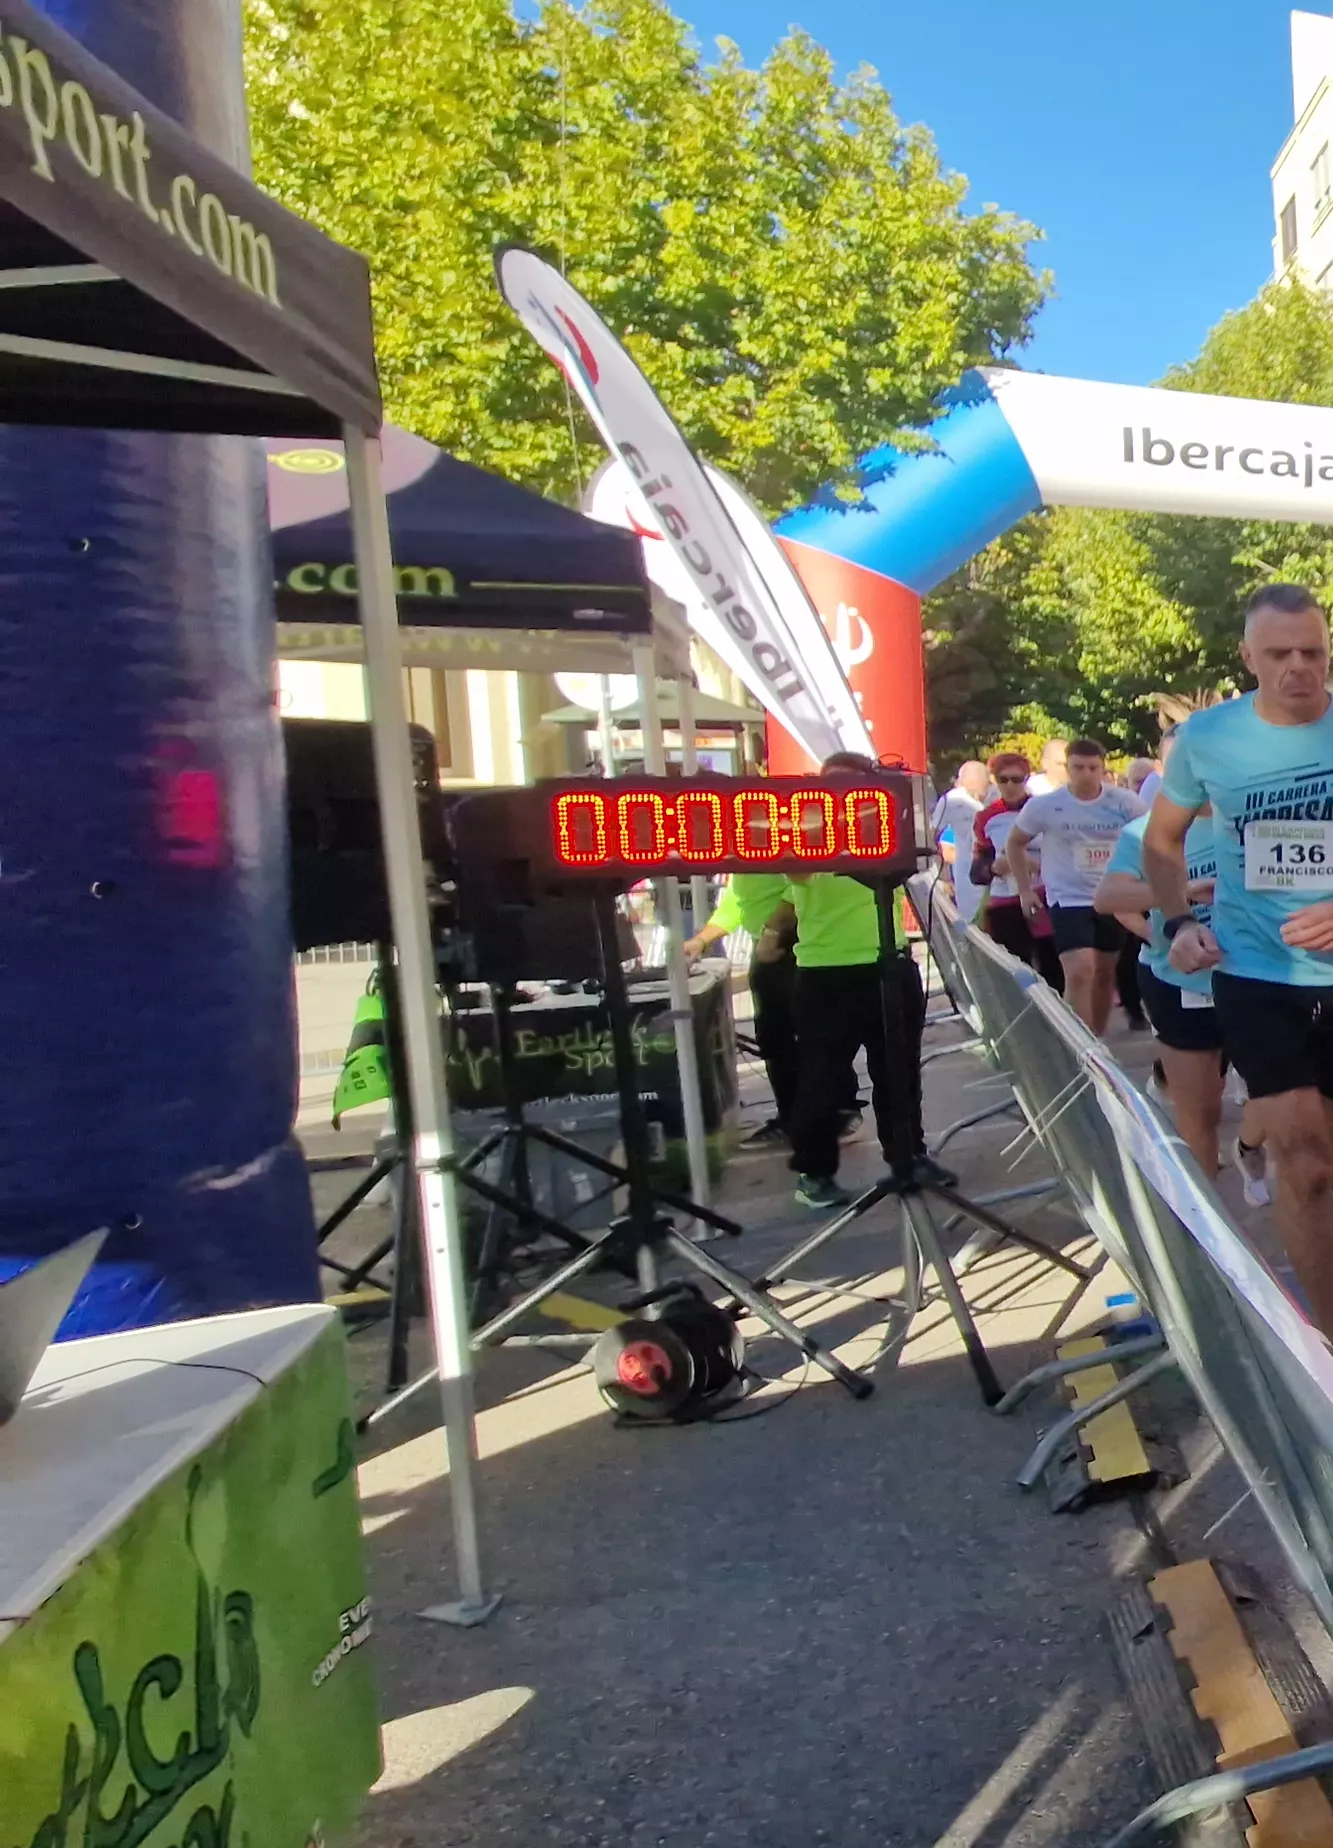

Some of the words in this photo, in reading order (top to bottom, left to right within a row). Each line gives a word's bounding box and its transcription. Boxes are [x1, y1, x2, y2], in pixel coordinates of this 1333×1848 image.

[1246, 791, 1265, 811] III
[1268, 780, 1328, 805] CARRERA
[556, 790, 890, 863] 00:00:00
[1270, 844, 1326, 864] 136
